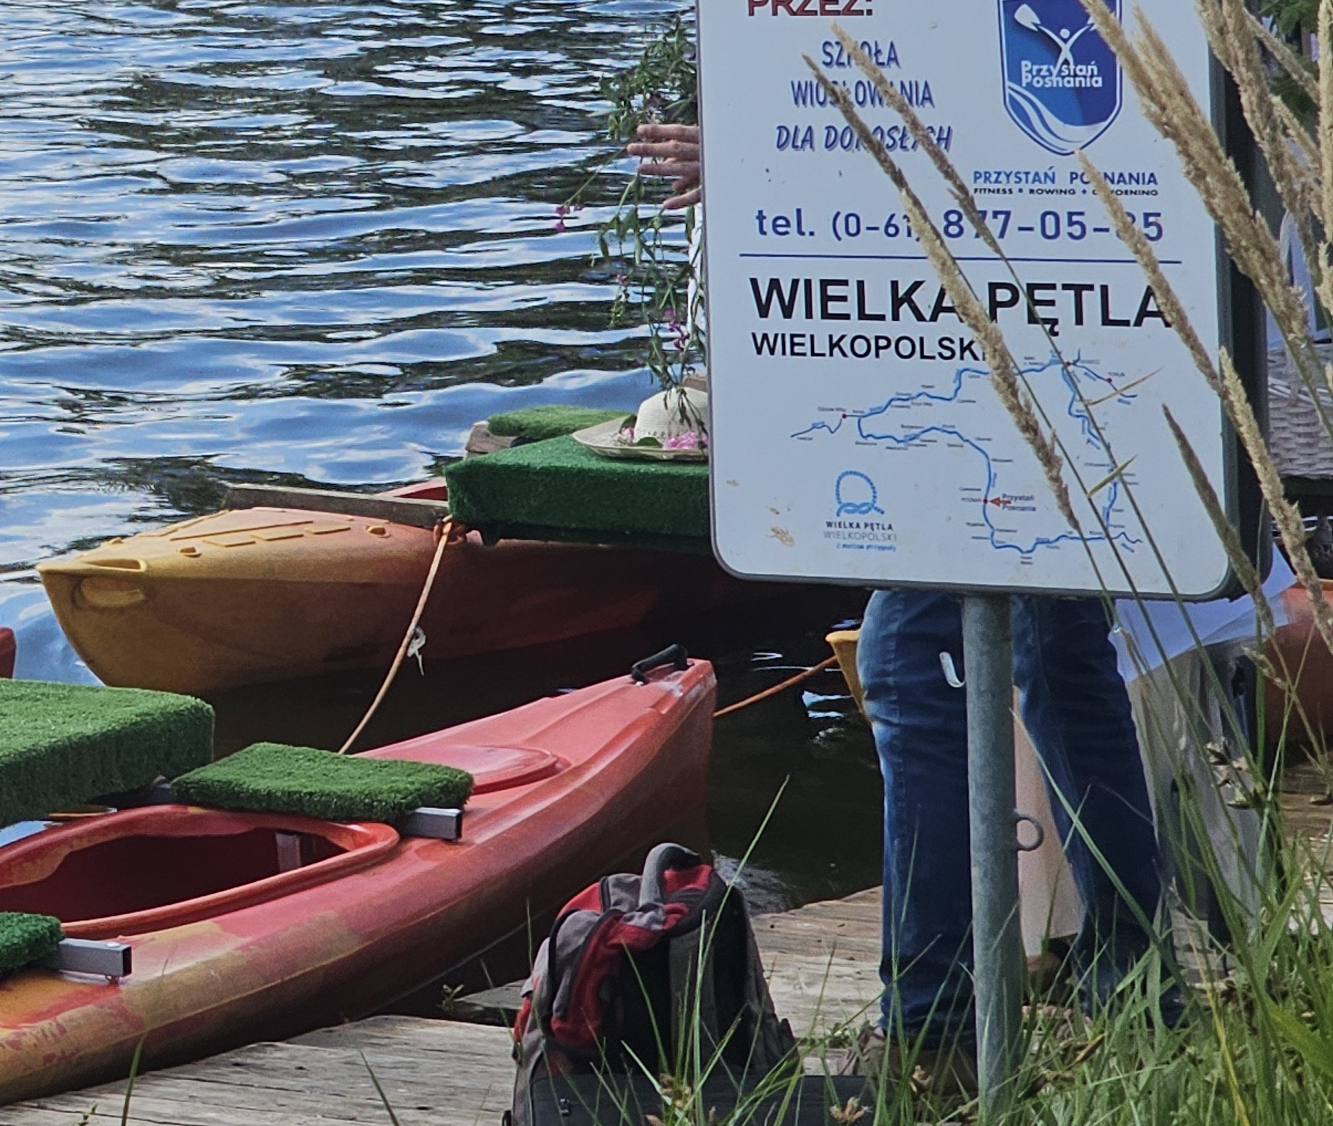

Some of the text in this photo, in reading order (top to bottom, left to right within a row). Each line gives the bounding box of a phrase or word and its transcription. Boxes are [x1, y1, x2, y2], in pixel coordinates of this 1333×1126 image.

[821, 40, 901, 68] SZOŁA
[1021, 60, 1099, 78] Przystań
[1021, 74, 1102, 88] Posnania
[775, 124, 816, 152] DLA
[973, 165, 1158, 186] PRZYSTAŃ PONANIA
[973, 187, 1014, 195] FITNESS
[1028, 188, 1076, 196] ROWING
[755, 208, 816, 237] tel.
[749, 277, 1175, 337] WIELKA PĘTLA
[823, 530, 898, 542] WIELKOPOLSKI
[825, 521, 894, 533] WIELKA PĘTLA
